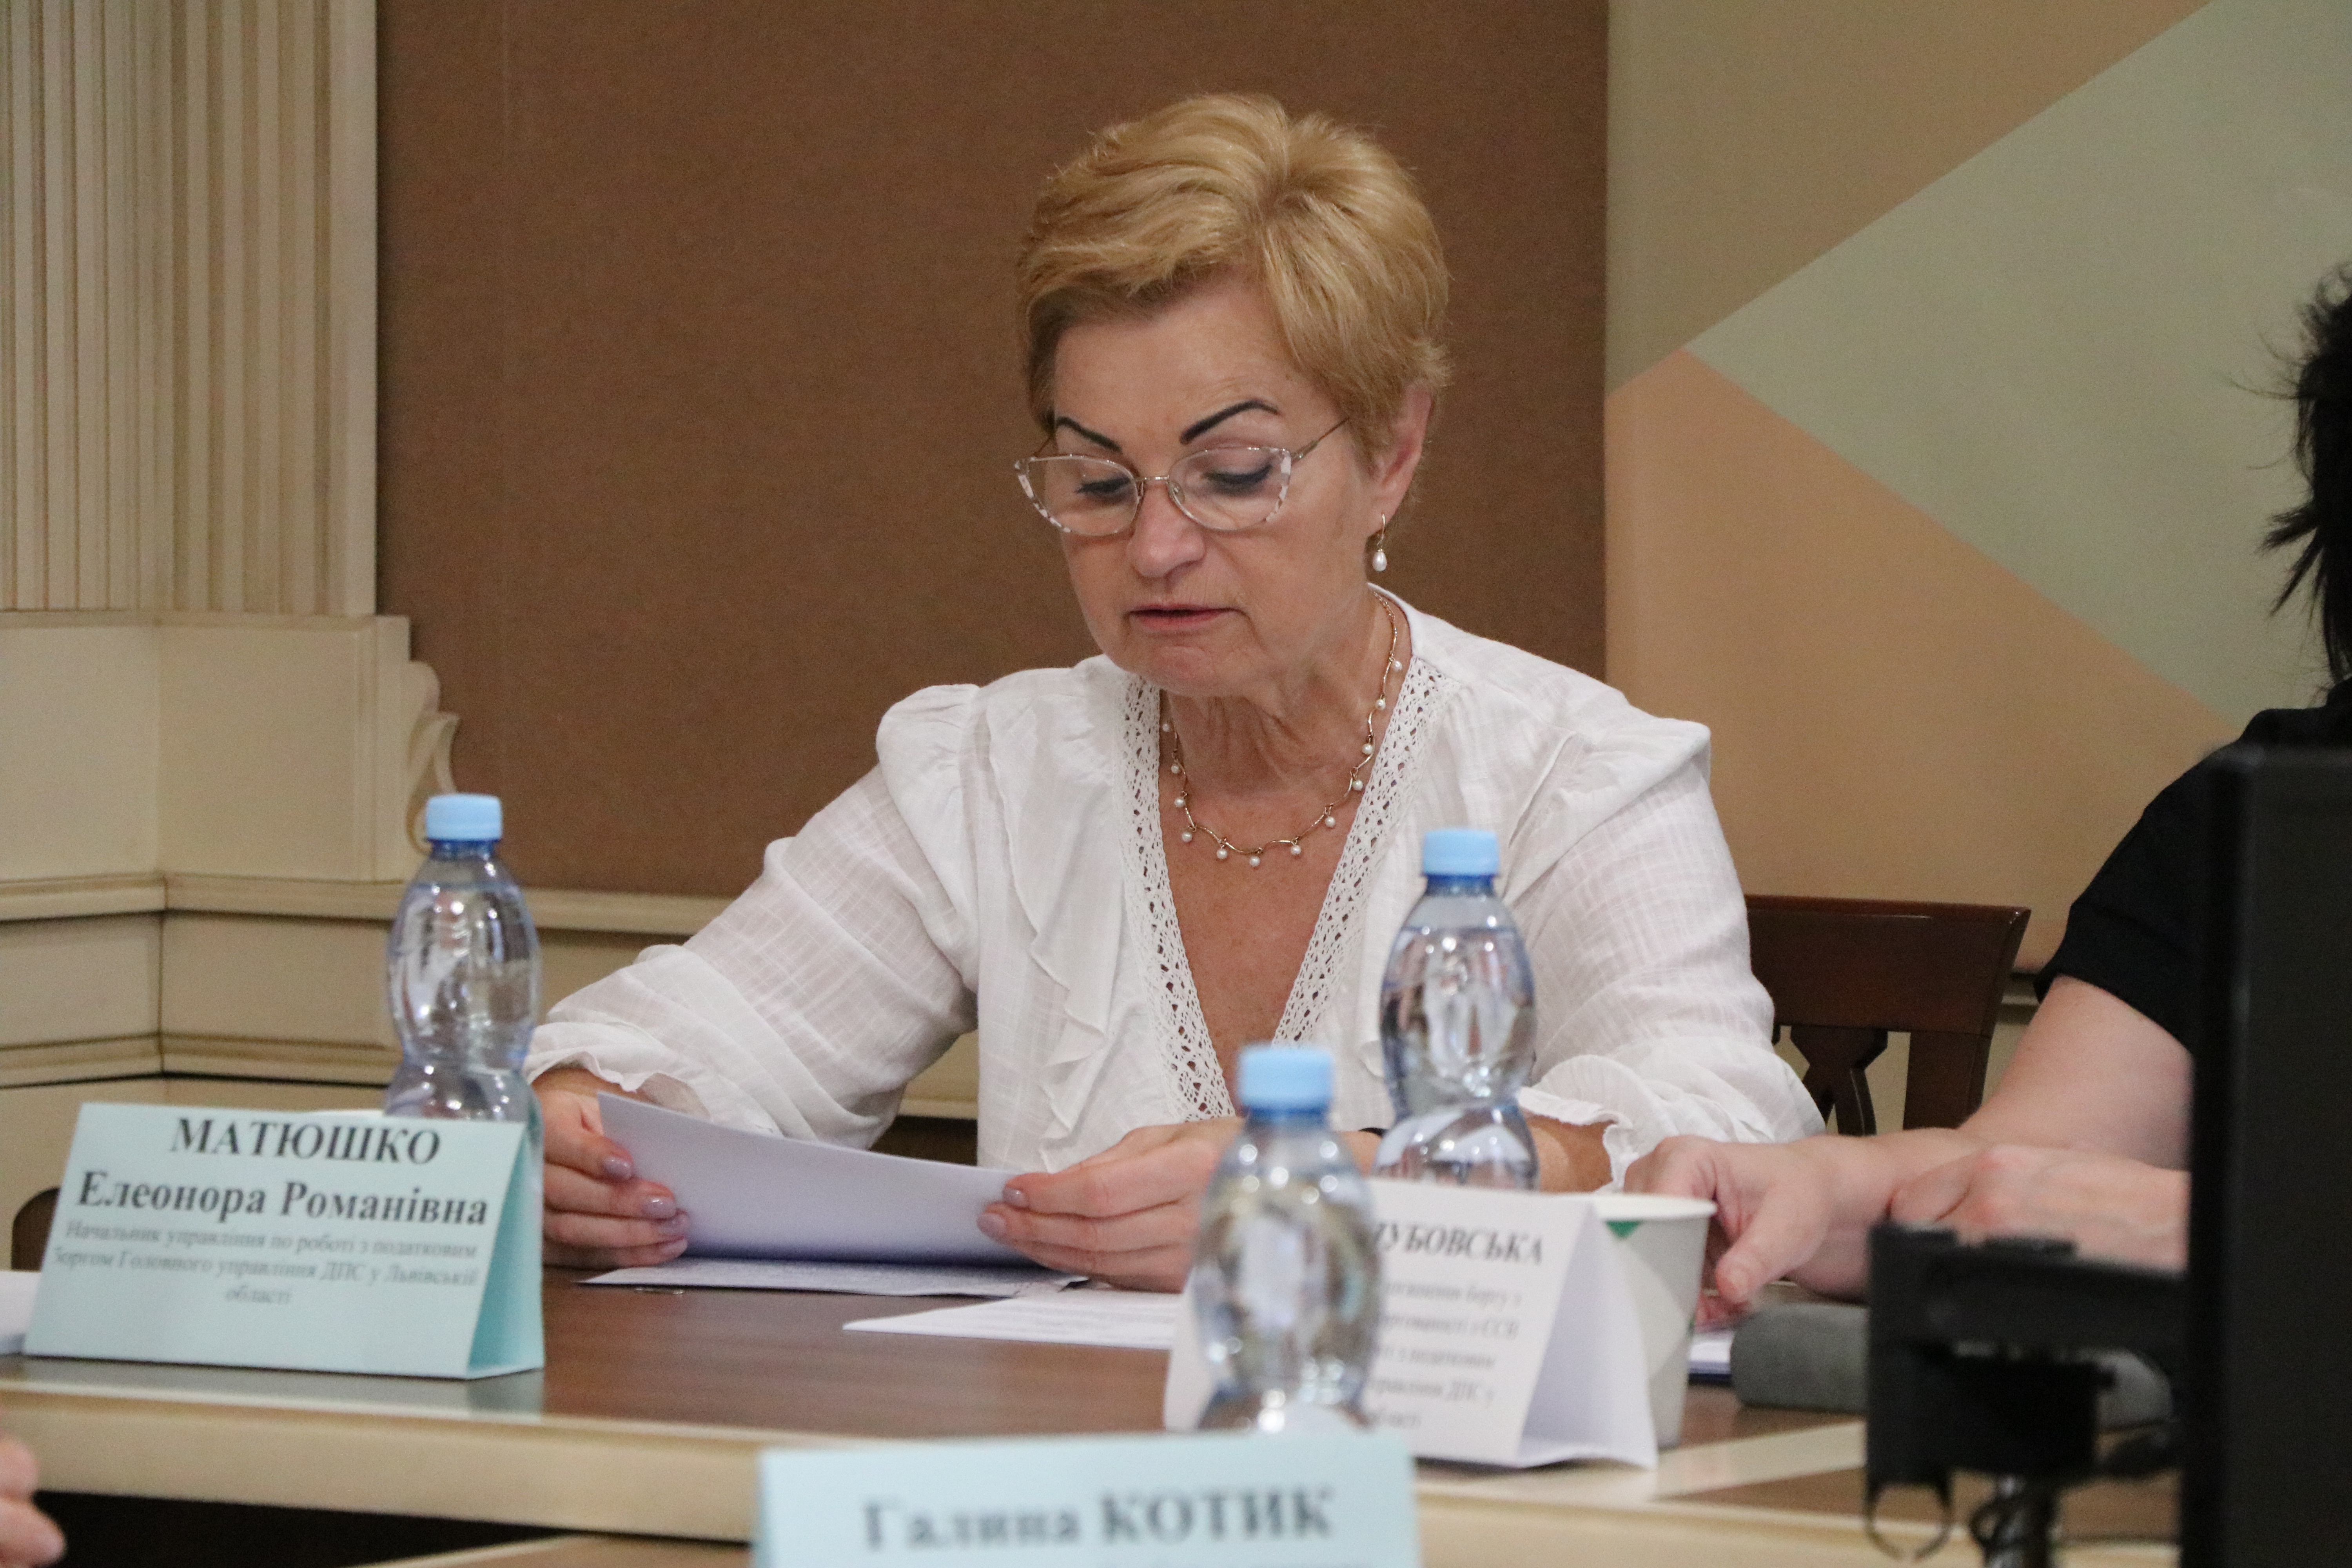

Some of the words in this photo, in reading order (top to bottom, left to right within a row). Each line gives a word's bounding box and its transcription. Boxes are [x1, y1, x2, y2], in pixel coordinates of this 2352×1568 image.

[171, 1117, 440, 1165] МАТЮШКО
[78, 1170, 264, 1223] Елеонора
[280, 1181, 487, 1225] Романівна
[270, 1236, 293, 1250] по
[295, 1234, 353, 1254] роботі
[862, 1497, 1082, 1552] Галина
[1099, 1486, 1335, 1545] КОТИК
